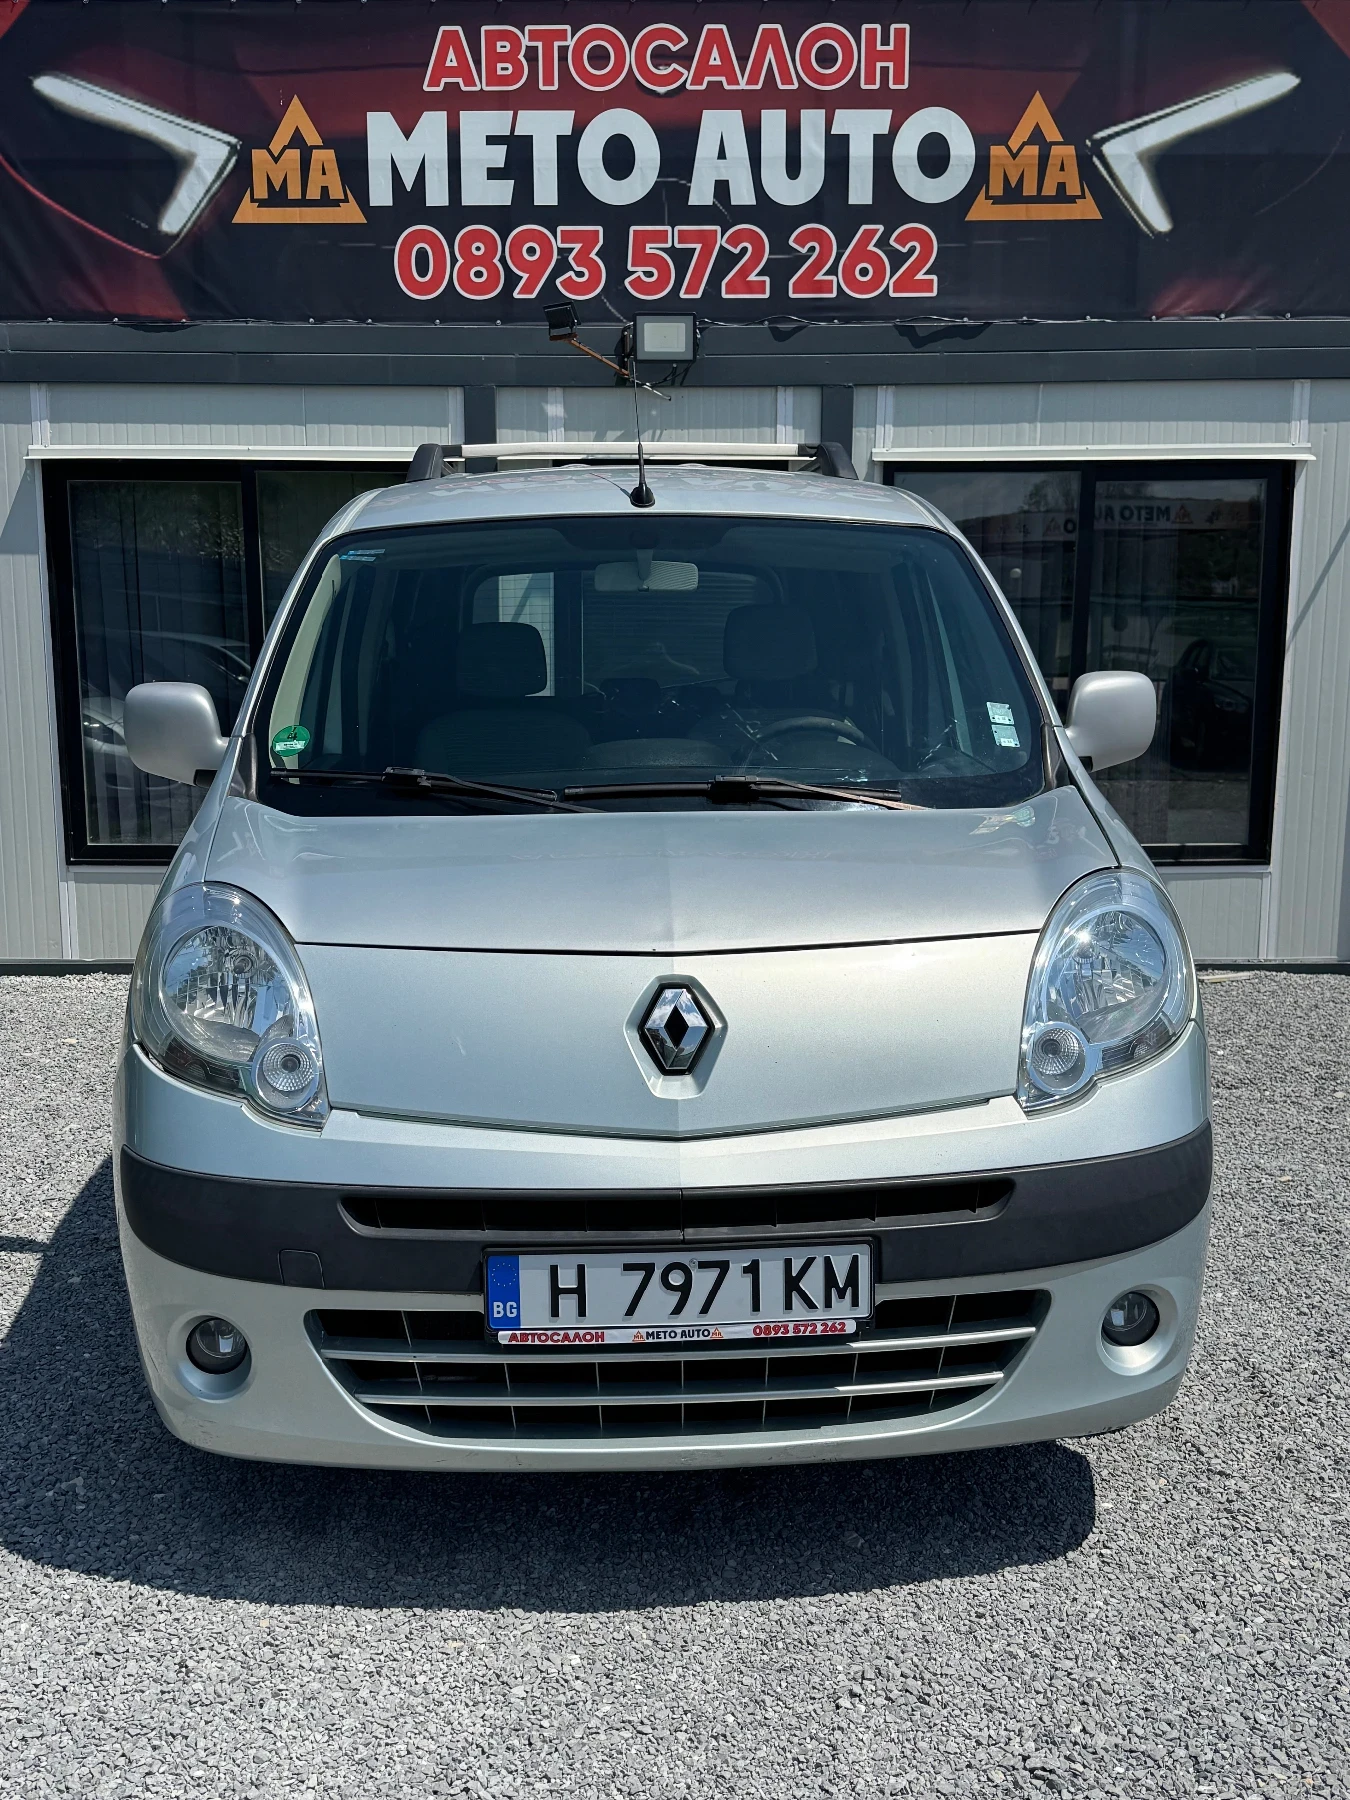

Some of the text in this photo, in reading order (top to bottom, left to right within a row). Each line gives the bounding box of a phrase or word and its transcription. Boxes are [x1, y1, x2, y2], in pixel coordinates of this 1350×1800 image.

[423, 23, 910, 91] АВТОСАЛОН
[252, 148, 345, 199] MA
[366, 106, 976, 206] METO AUTO
[988, 145, 1082, 196] MA
[394, 223, 938, 300] 0893 572 262
[492, 1301, 518, 1318] BG
[549, 1253, 861, 1318] H 7971 KM
[508, 1331, 605, 1343] АВТОСАЛОН
[645, 1330, 678, 1340] METO
[680, 1328, 711, 1339] AUTO
[752, 1321, 847, 1337] 0893 572 262
